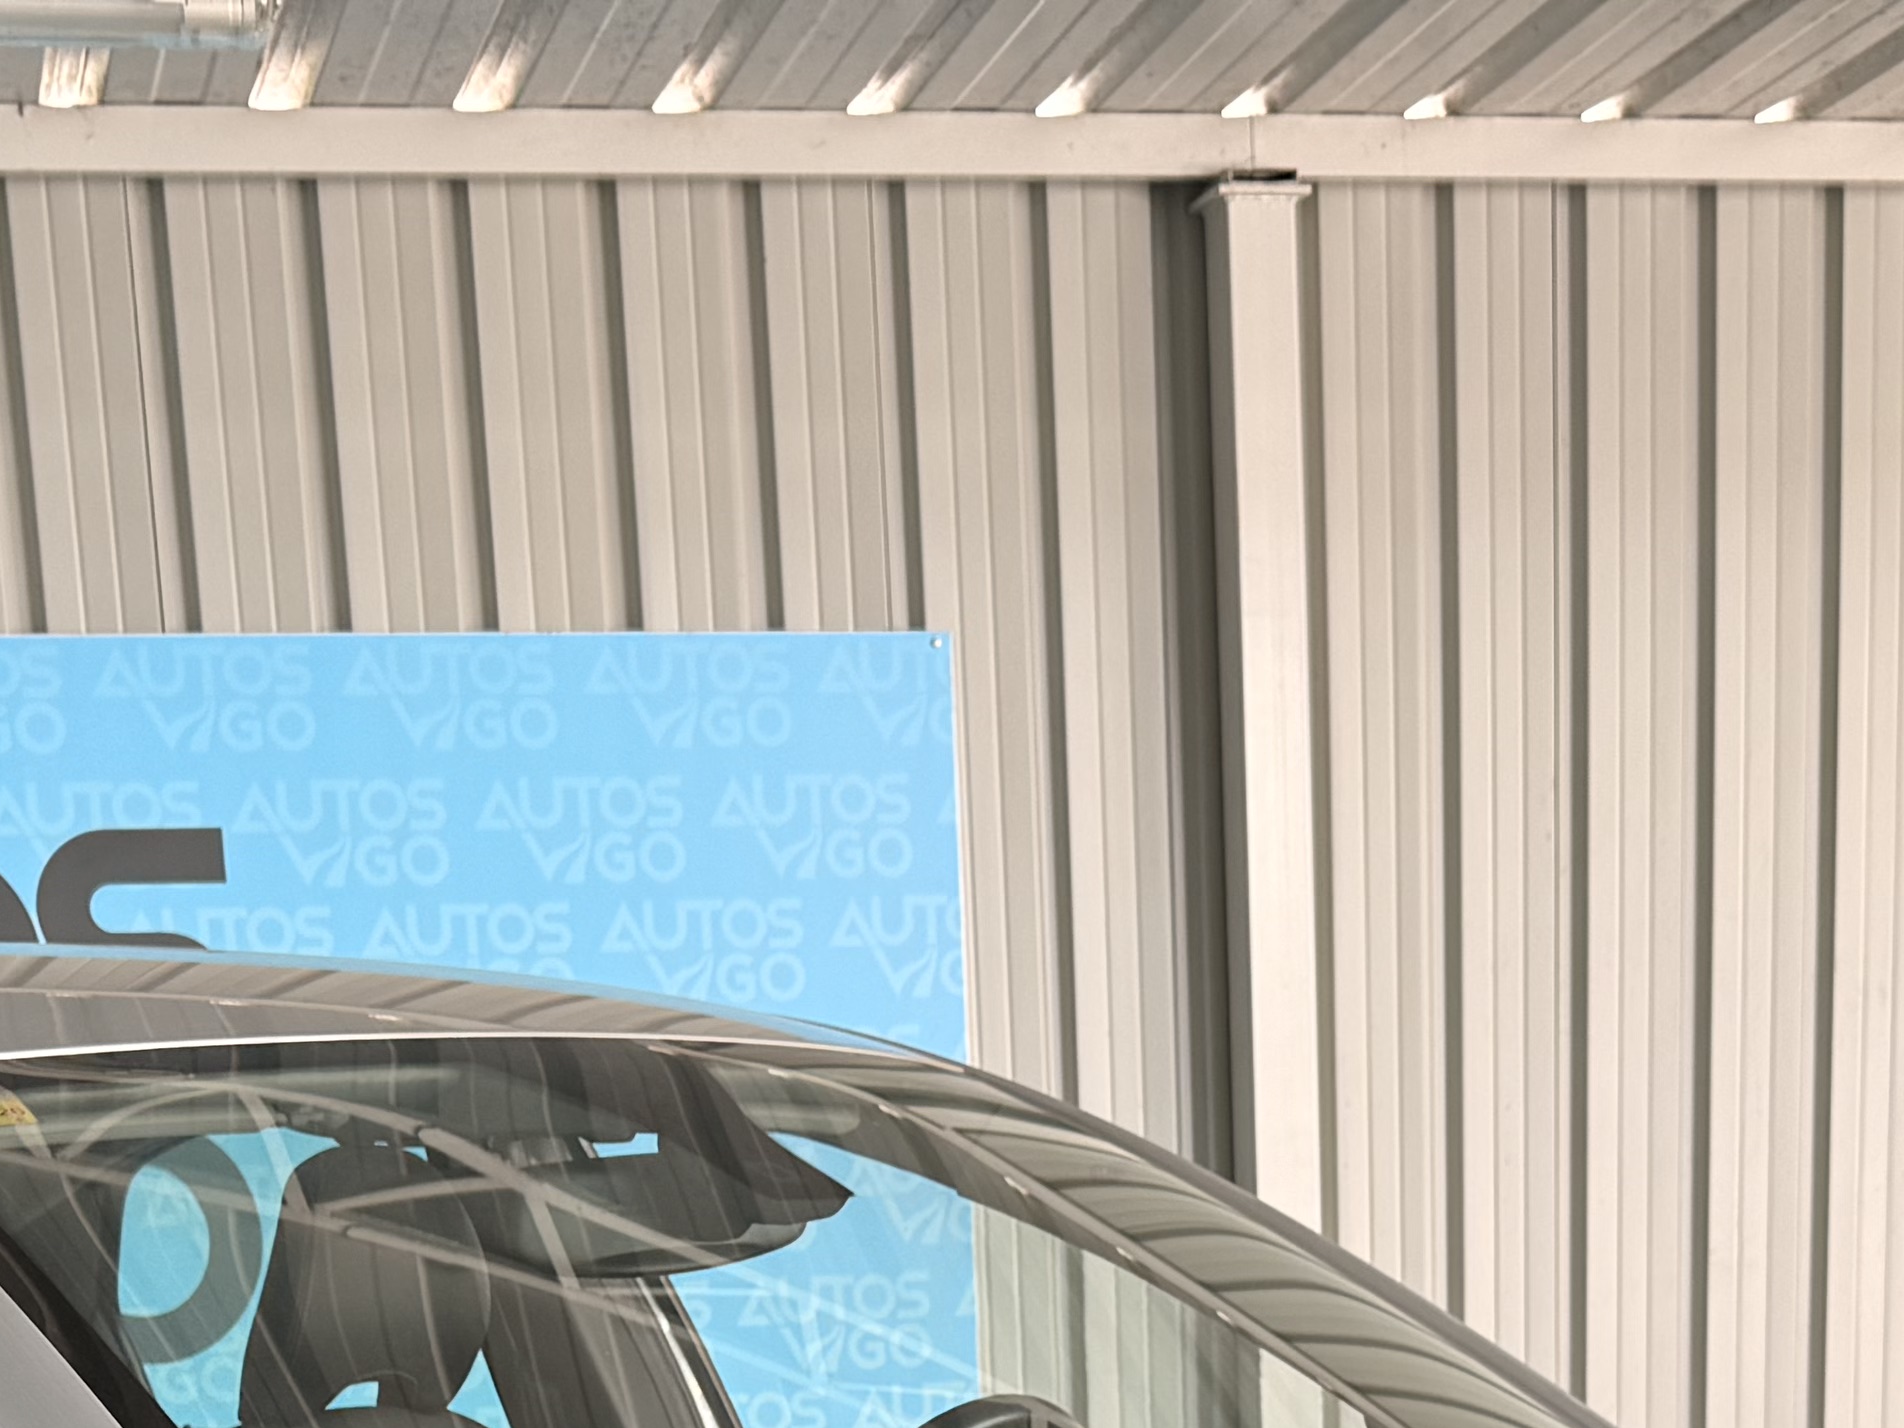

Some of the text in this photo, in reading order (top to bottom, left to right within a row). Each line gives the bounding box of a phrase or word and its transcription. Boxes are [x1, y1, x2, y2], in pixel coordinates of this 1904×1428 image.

[93, 643, 313, 698] AUTOS
[341, 642, 555, 697] AUTOS
[583, 642, 790, 696] AUTOS
[142, 699, 317, 754] VIGO
[390, 698, 559, 751] VIGO
[631, 696, 793, 750] VIGO
[230, 778, 448, 833] AUTOS
[475, 776, 684, 831] AUTOS
[709, 773, 911, 828] AUTOS
[280, 832, 450, 888] VIGO
[522, 831, 687, 884] VIGO
[755, 828, 913, 880] VIGO
[361, 899, 573, 957] AUTOS
[601, 897, 804, 952] AUTOS
